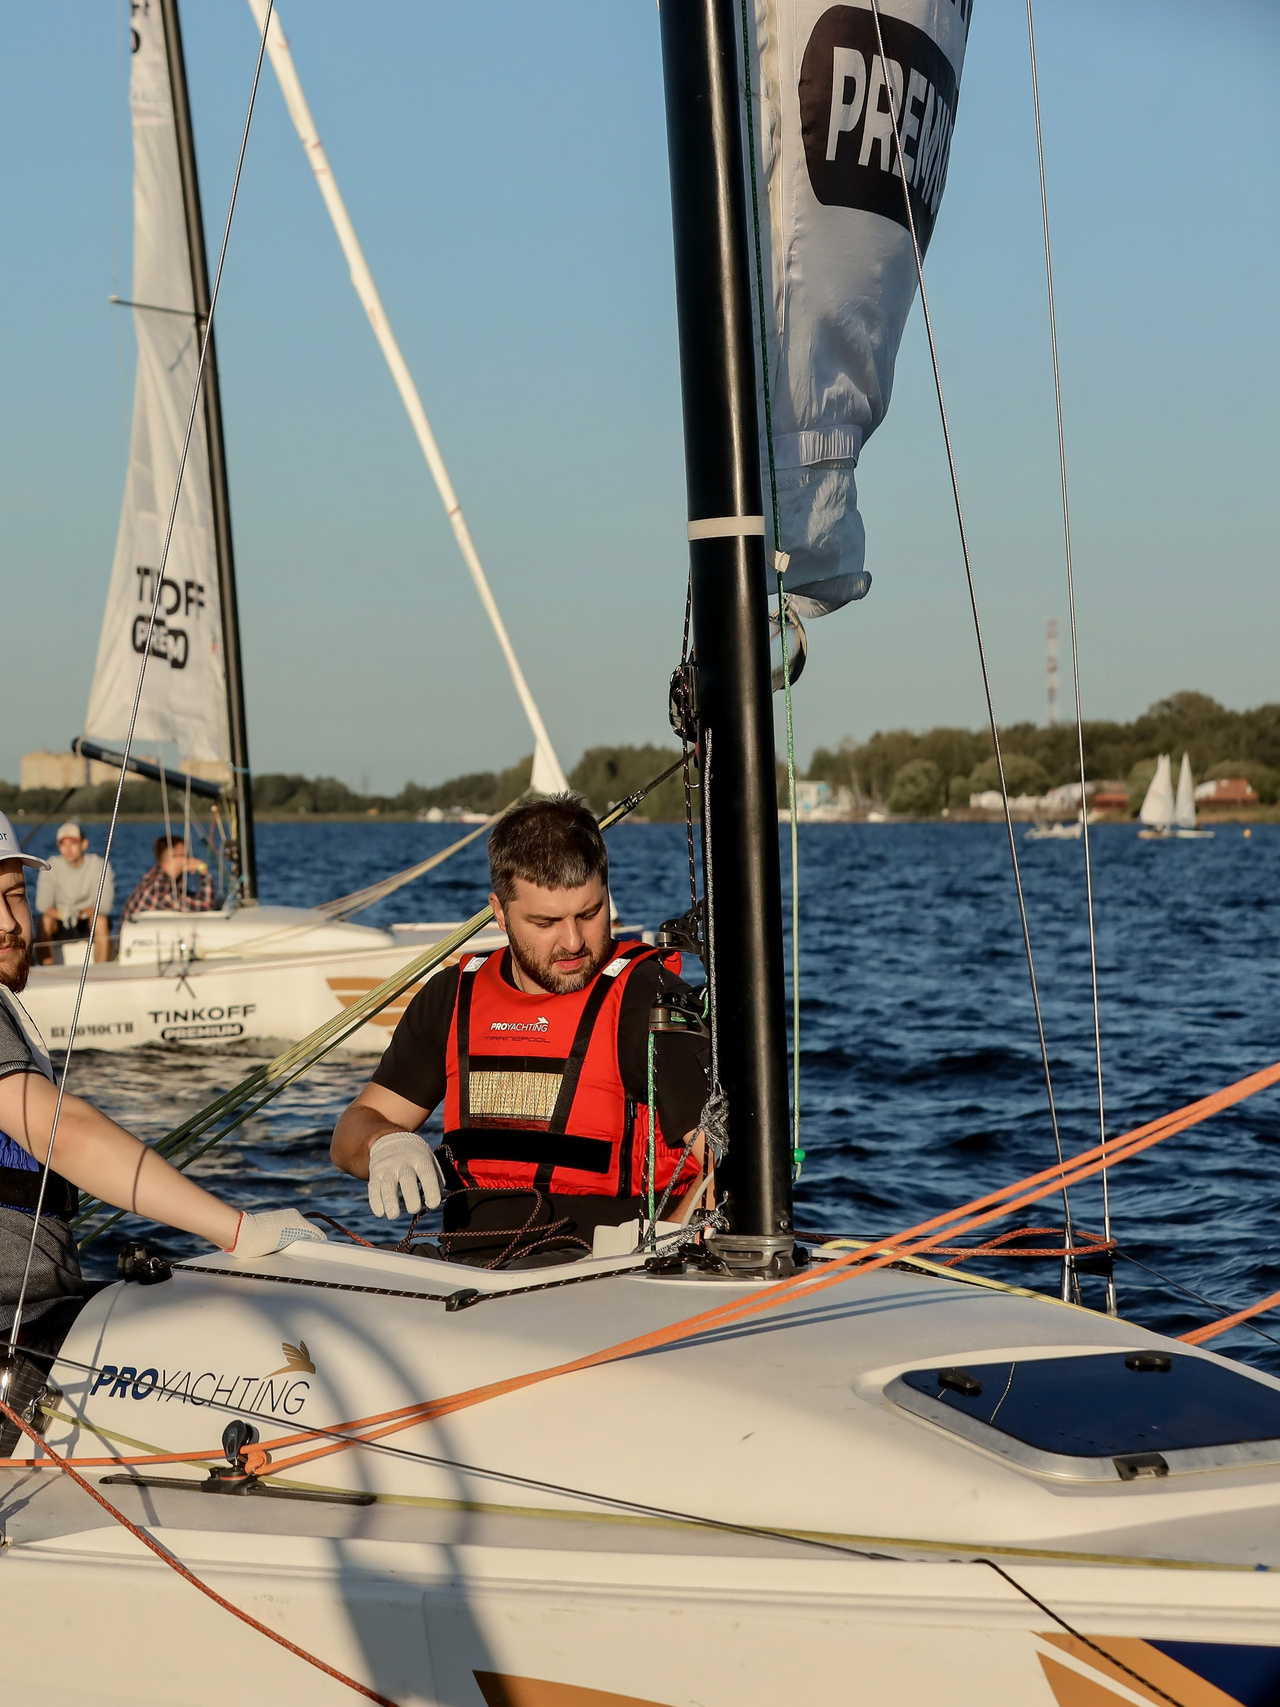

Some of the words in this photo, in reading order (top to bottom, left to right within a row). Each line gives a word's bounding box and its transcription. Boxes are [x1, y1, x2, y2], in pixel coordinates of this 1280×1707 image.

[148, 1004, 256, 1023] TINKOFF
[490, 1022, 549, 1032] PROYACHTING
[90, 1365, 310, 1415] PROYACHTING
